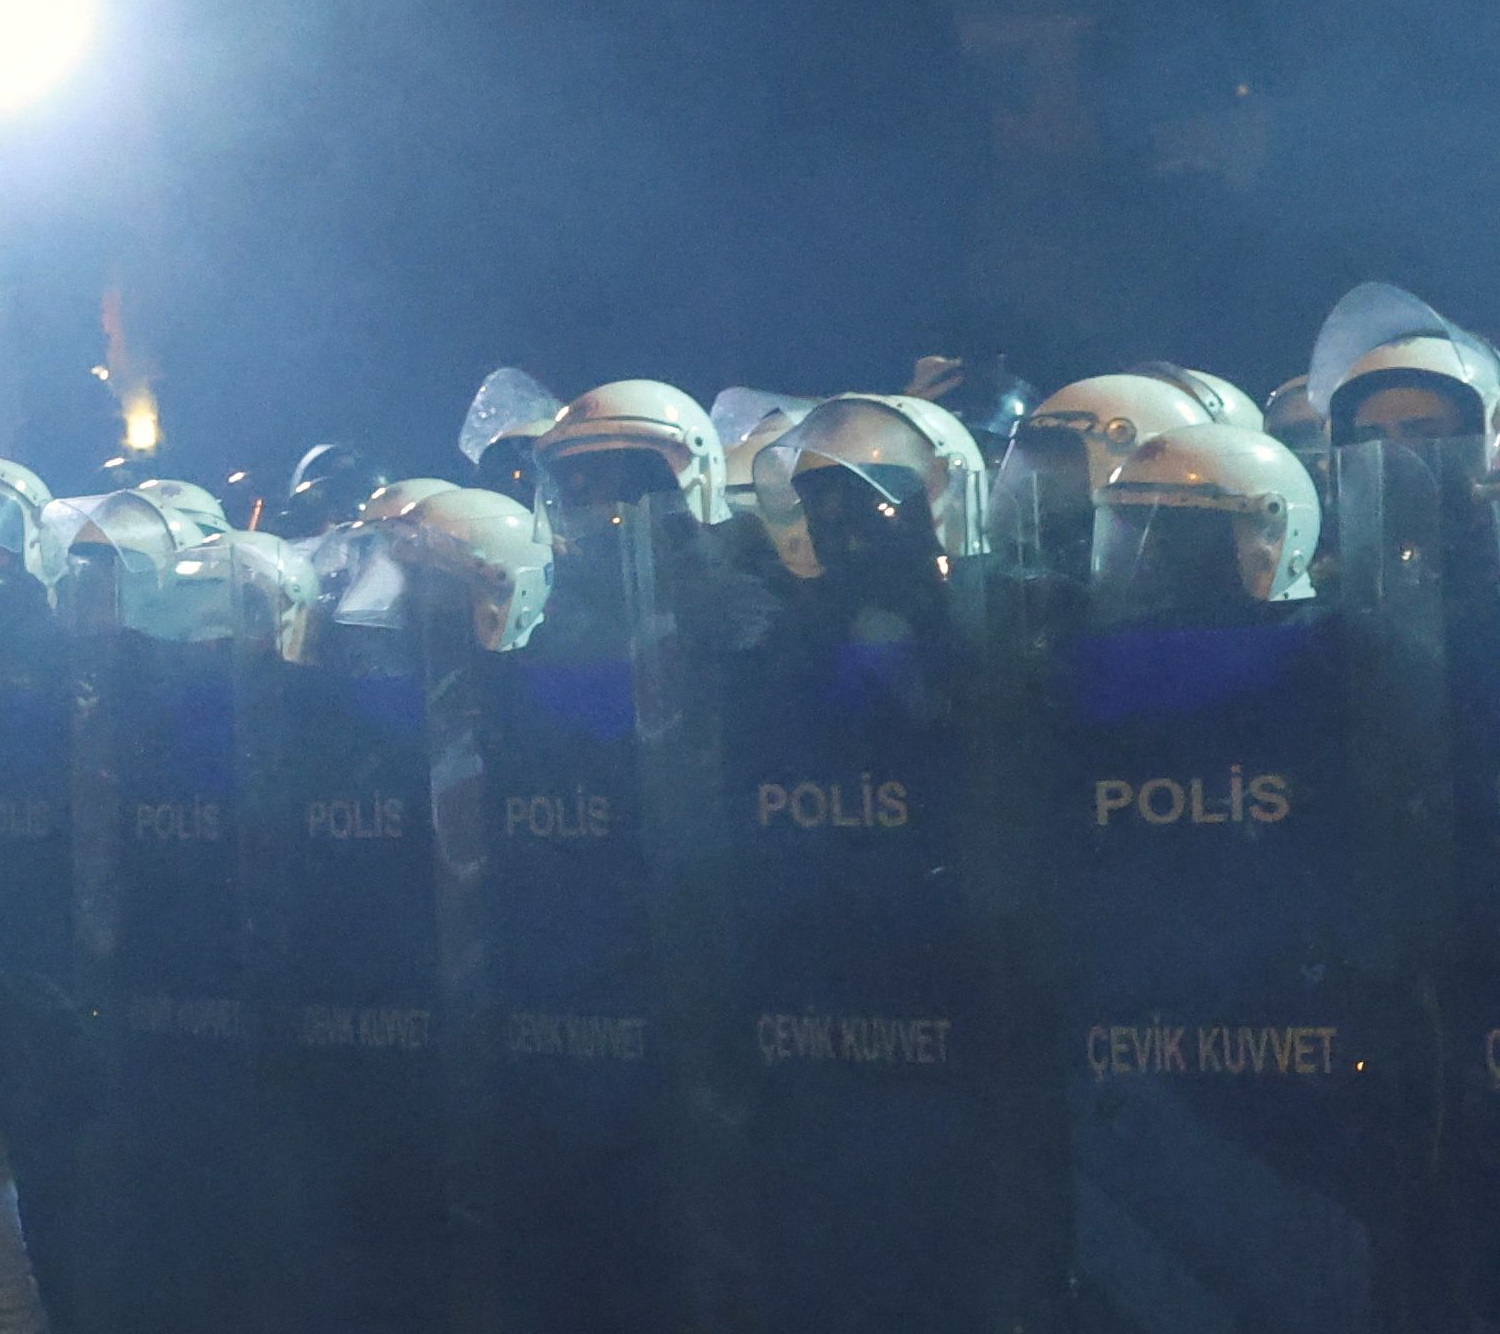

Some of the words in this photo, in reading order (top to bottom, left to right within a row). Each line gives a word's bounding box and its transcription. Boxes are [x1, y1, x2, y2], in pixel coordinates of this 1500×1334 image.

[136, 793, 220, 841] POLİS
[308, 789, 404, 839] POLİS
[505, 783, 611, 838] POLİS
[758, 771, 910, 829] POLİS
[1093, 763, 1293, 827] POLİS
[841, 1016, 952, 1065] KUVVET
[1086, 1009, 1187, 1084] ÇEVİK
[1197, 1025, 1339, 1076] KUVVET
